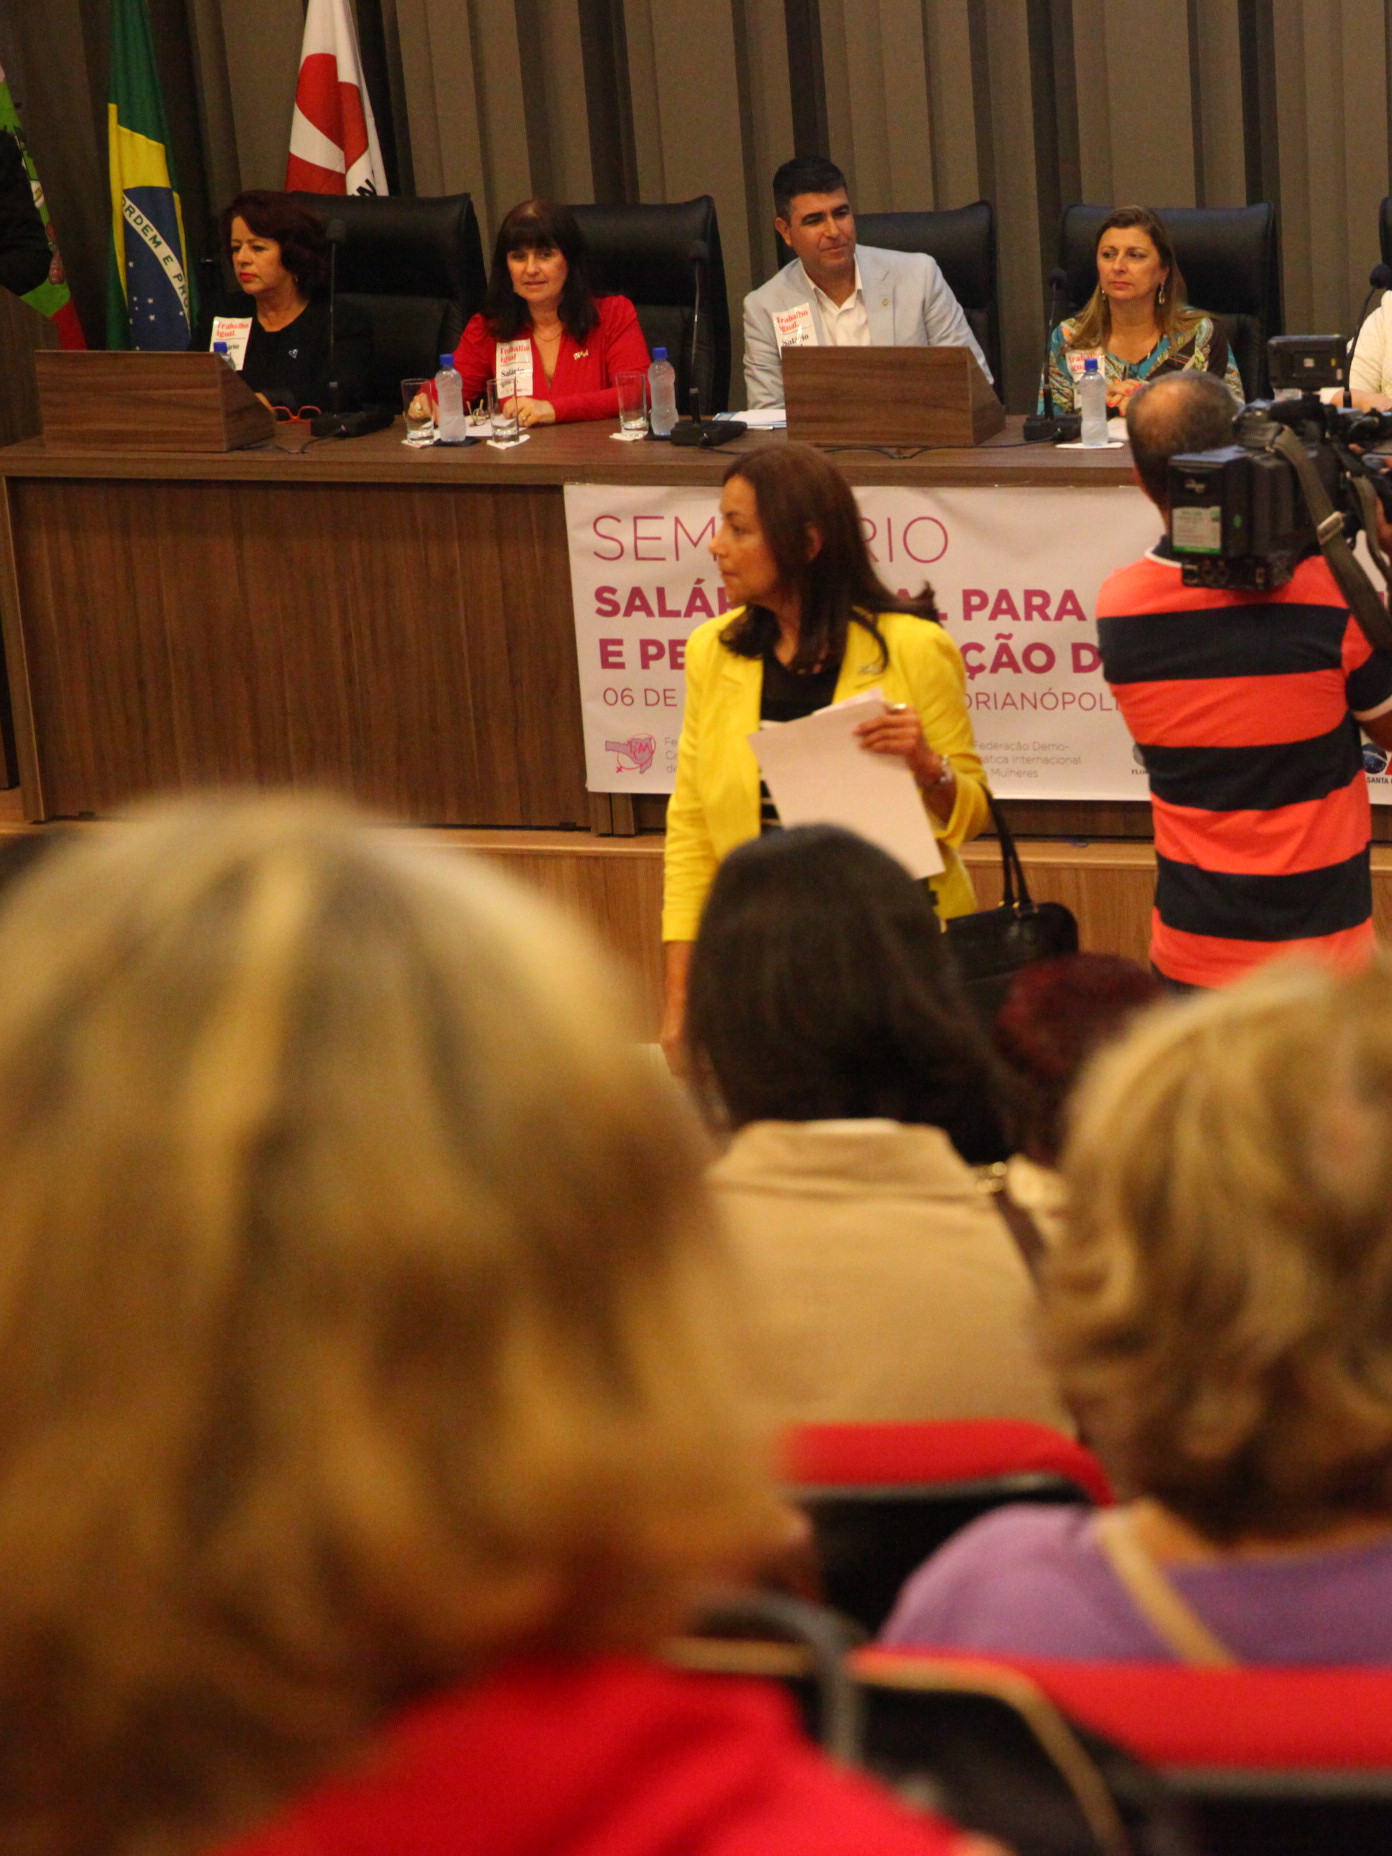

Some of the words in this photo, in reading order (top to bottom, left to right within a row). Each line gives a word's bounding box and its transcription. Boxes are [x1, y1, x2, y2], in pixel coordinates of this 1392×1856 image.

[962, 588, 1087, 622] PARA
[598, 638, 626, 671] E
[602, 687, 635, 707] 06
[643, 688, 678, 707] DE
[1012, 754, 1081, 765] Internacional
[990, 768, 1039, 778] Mulheres
[1366, 776, 1388, 785] SANTA
